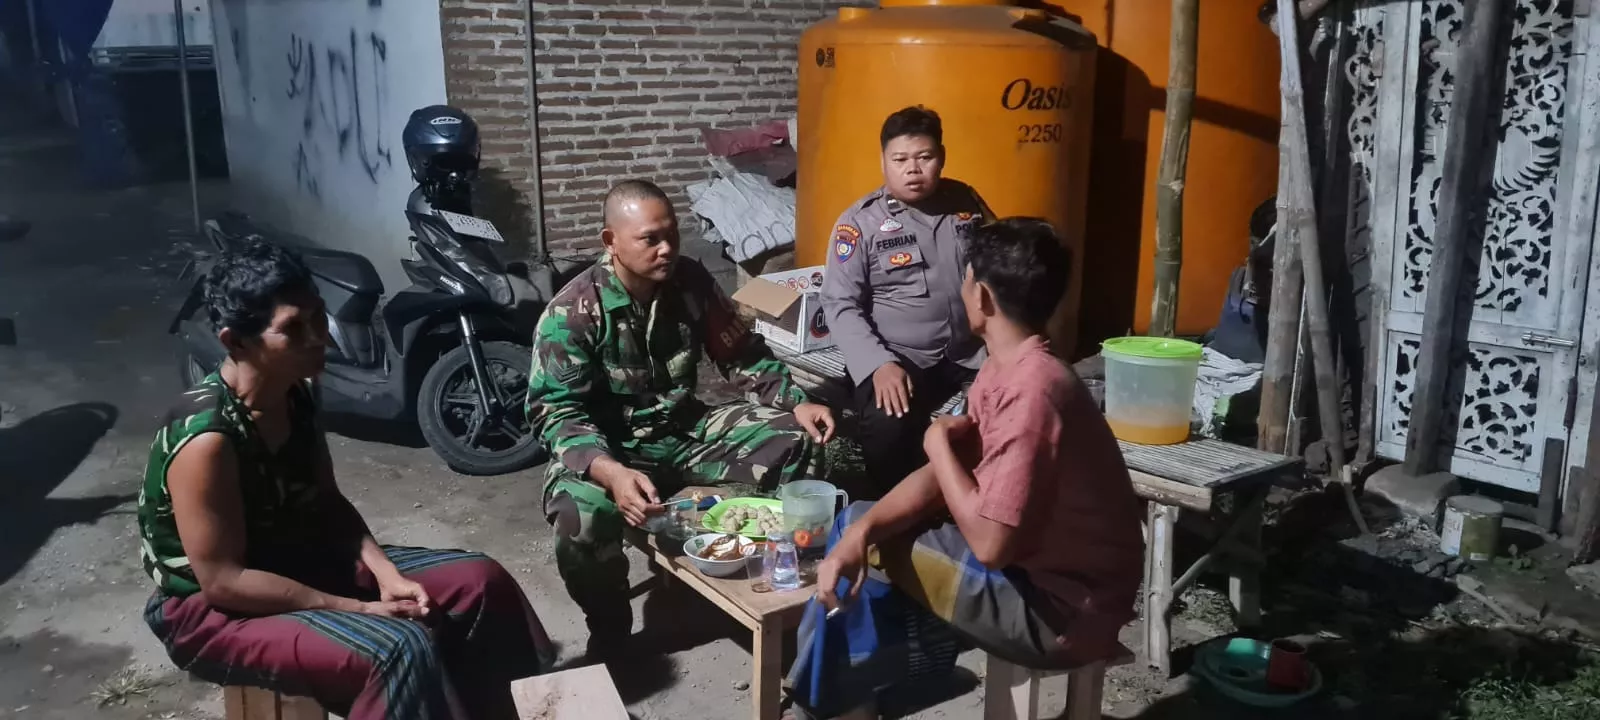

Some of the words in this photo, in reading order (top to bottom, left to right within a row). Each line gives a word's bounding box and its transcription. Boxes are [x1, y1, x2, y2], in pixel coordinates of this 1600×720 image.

[1001, 78, 1073, 111] Oasis
[1017, 123, 1063, 144] 2250
[875, 233, 917, 251] FEBRIAN
[440, 275, 465, 295] HONDA
